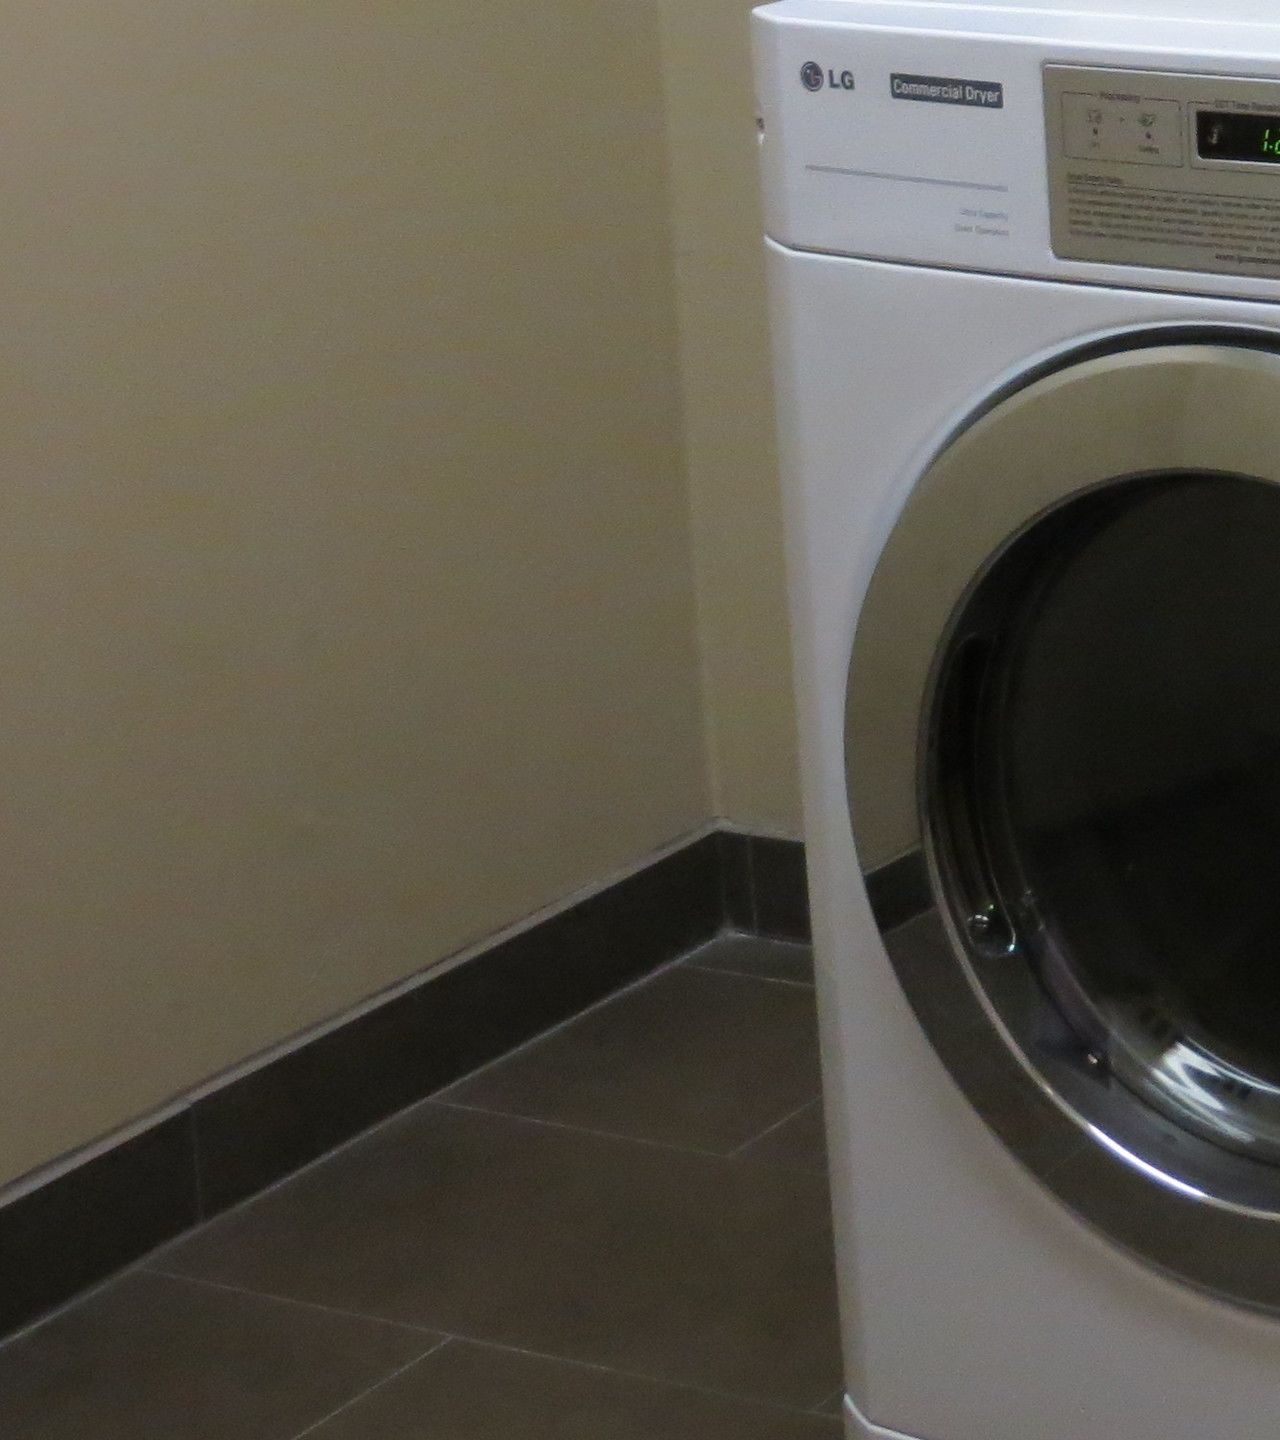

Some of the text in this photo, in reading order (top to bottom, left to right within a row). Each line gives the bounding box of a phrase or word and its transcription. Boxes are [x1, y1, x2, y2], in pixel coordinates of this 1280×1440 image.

[828, 69, 855, 90] LG
[893, 79, 1000, 104] Commercial Dryer
